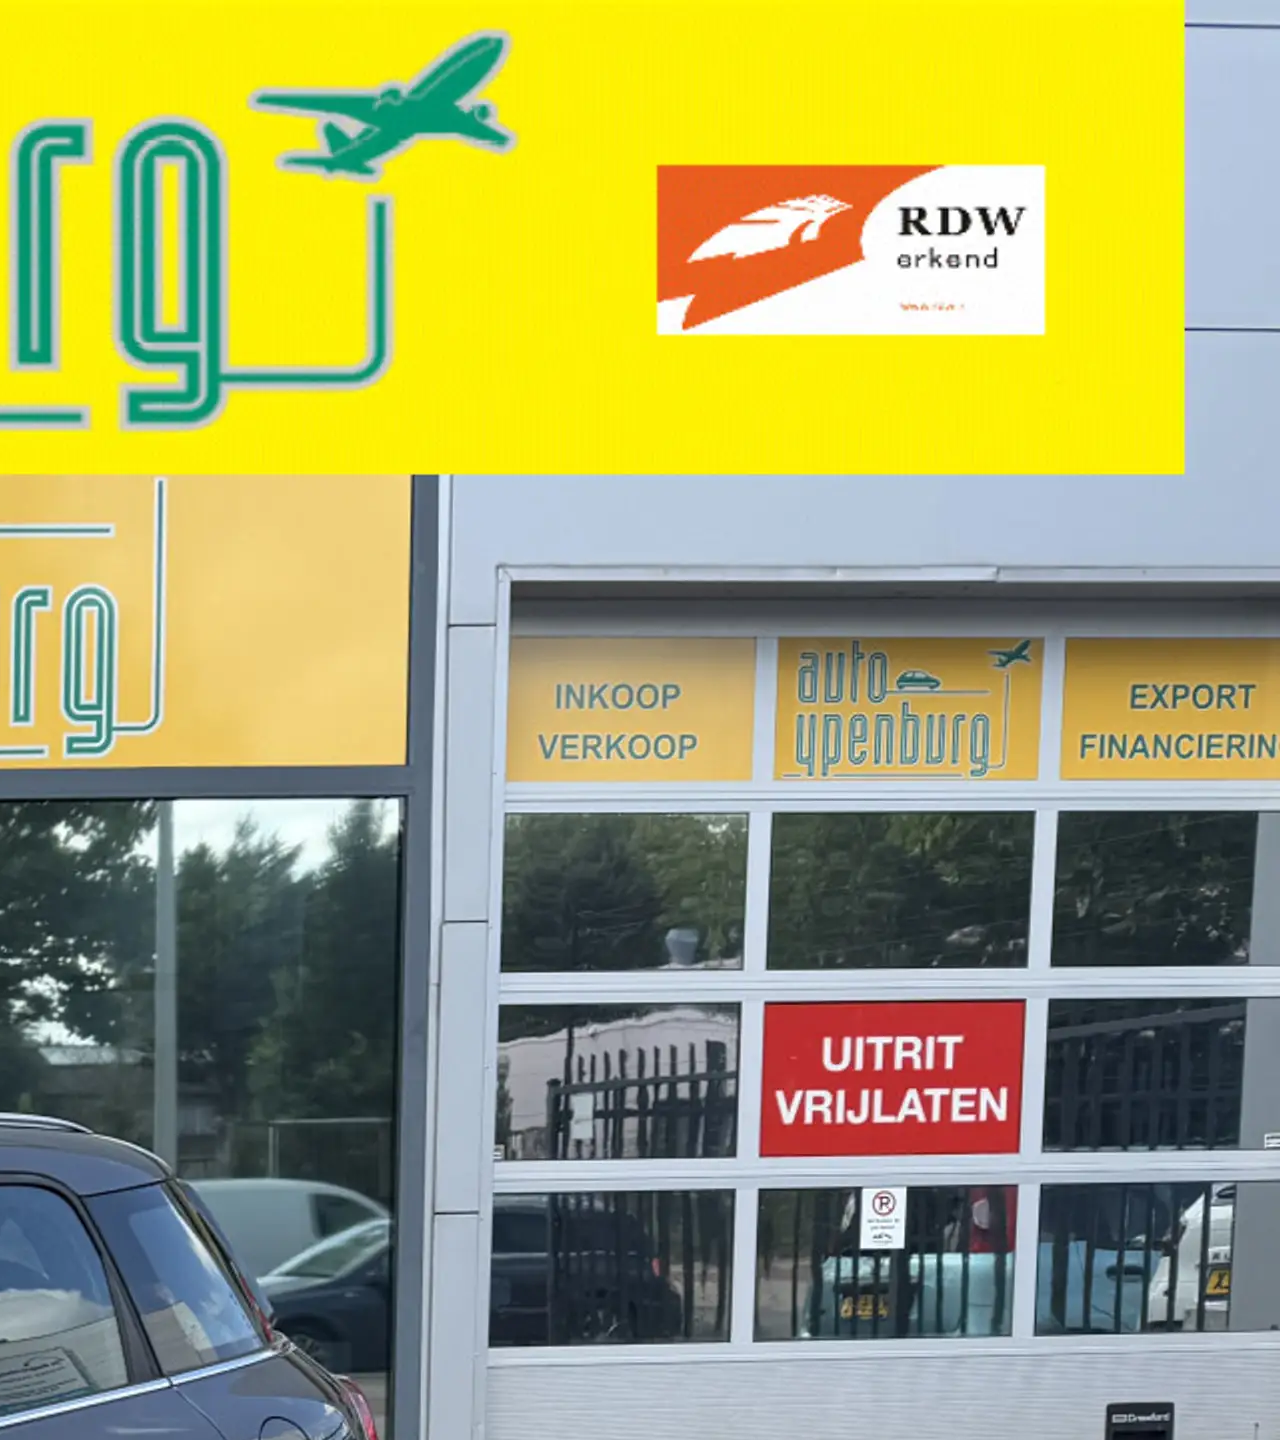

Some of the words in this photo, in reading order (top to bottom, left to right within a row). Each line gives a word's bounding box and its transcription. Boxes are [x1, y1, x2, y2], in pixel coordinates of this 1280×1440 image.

[797, 639, 888, 704] auto
[555, 683, 682, 710] INKOOP
[1130, 683, 1257, 710] EXPORT
[537, 733, 698, 761] VERKOOP
[795, 701, 991, 778] ypenburg
[822, 1035, 965, 1072] UITRIT
[775, 1087, 1008, 1125] VRIJLATEN
